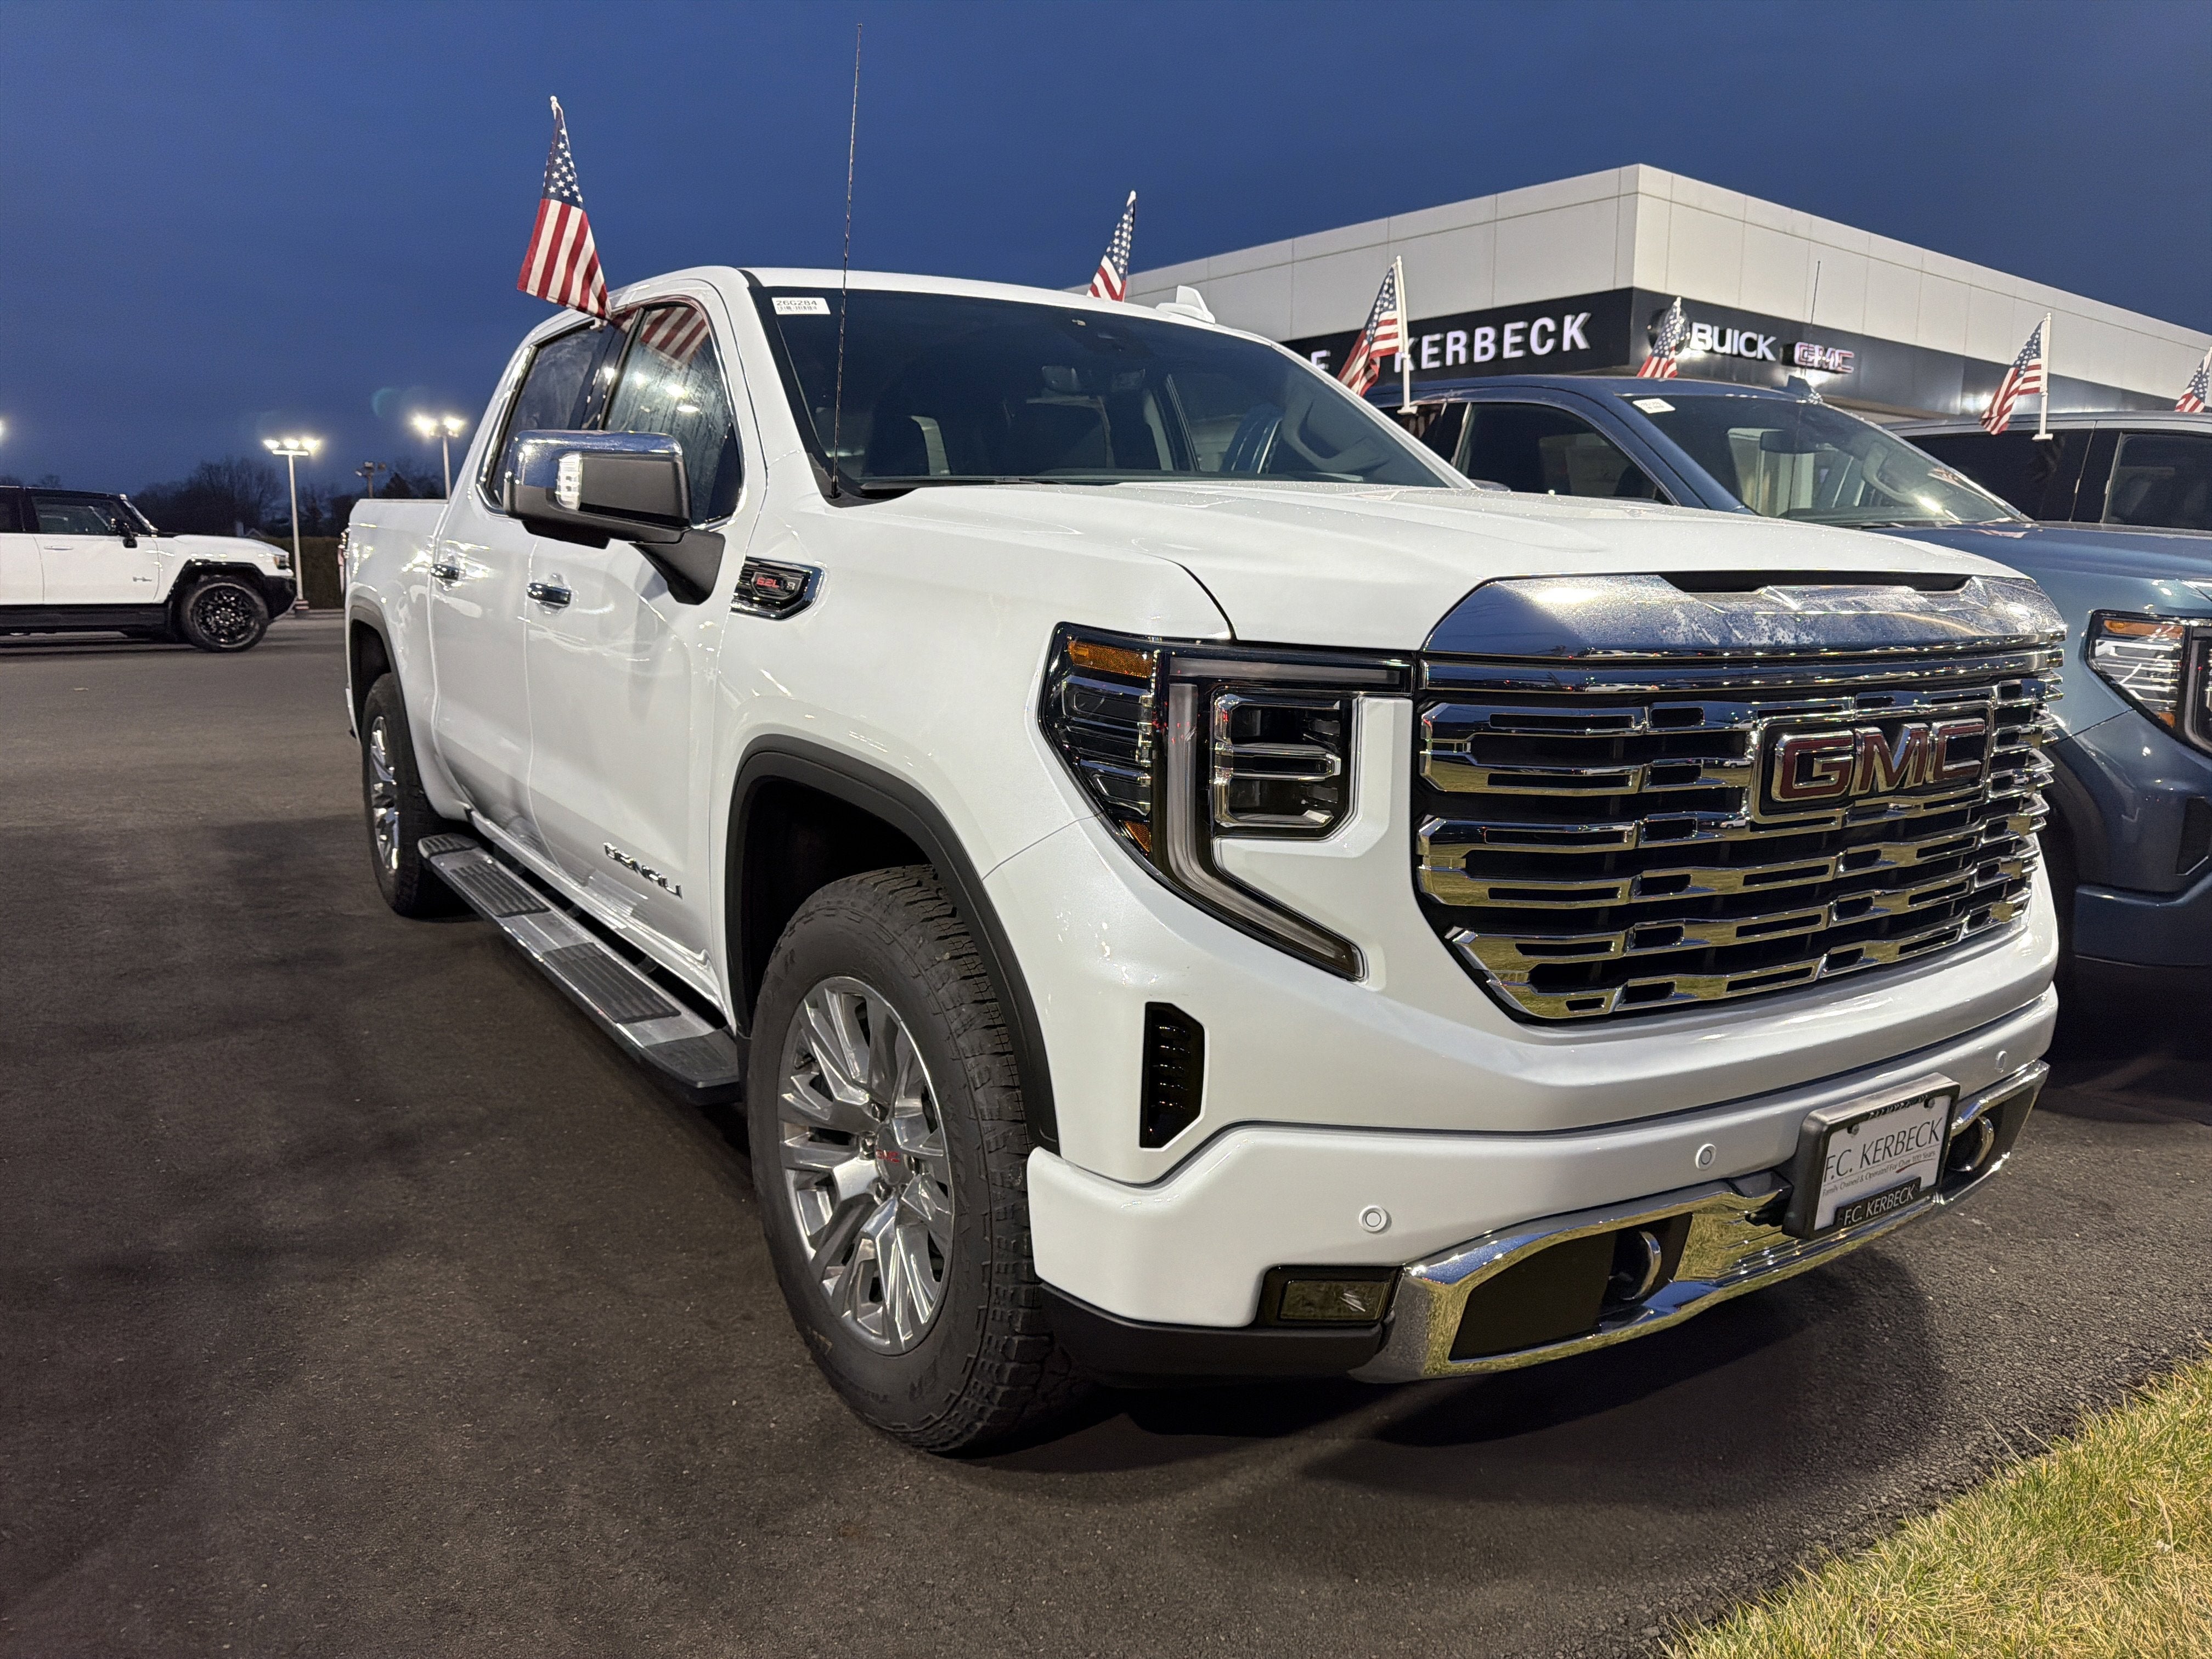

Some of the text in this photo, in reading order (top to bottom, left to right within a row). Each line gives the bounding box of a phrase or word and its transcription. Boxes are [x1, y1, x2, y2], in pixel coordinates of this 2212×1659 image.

[1394, 312, 1590, 373] KERBECK
[1689, 321, 1777, 361] BUICK
[1793, 341, 1855, 374] GMC
[1771, 718, 1985, 802] GMC
[1823, 1117, 1943, 1183] F.C. KERBECK
[1843, 1183, 1916, 1226] F.C. KERBECK
